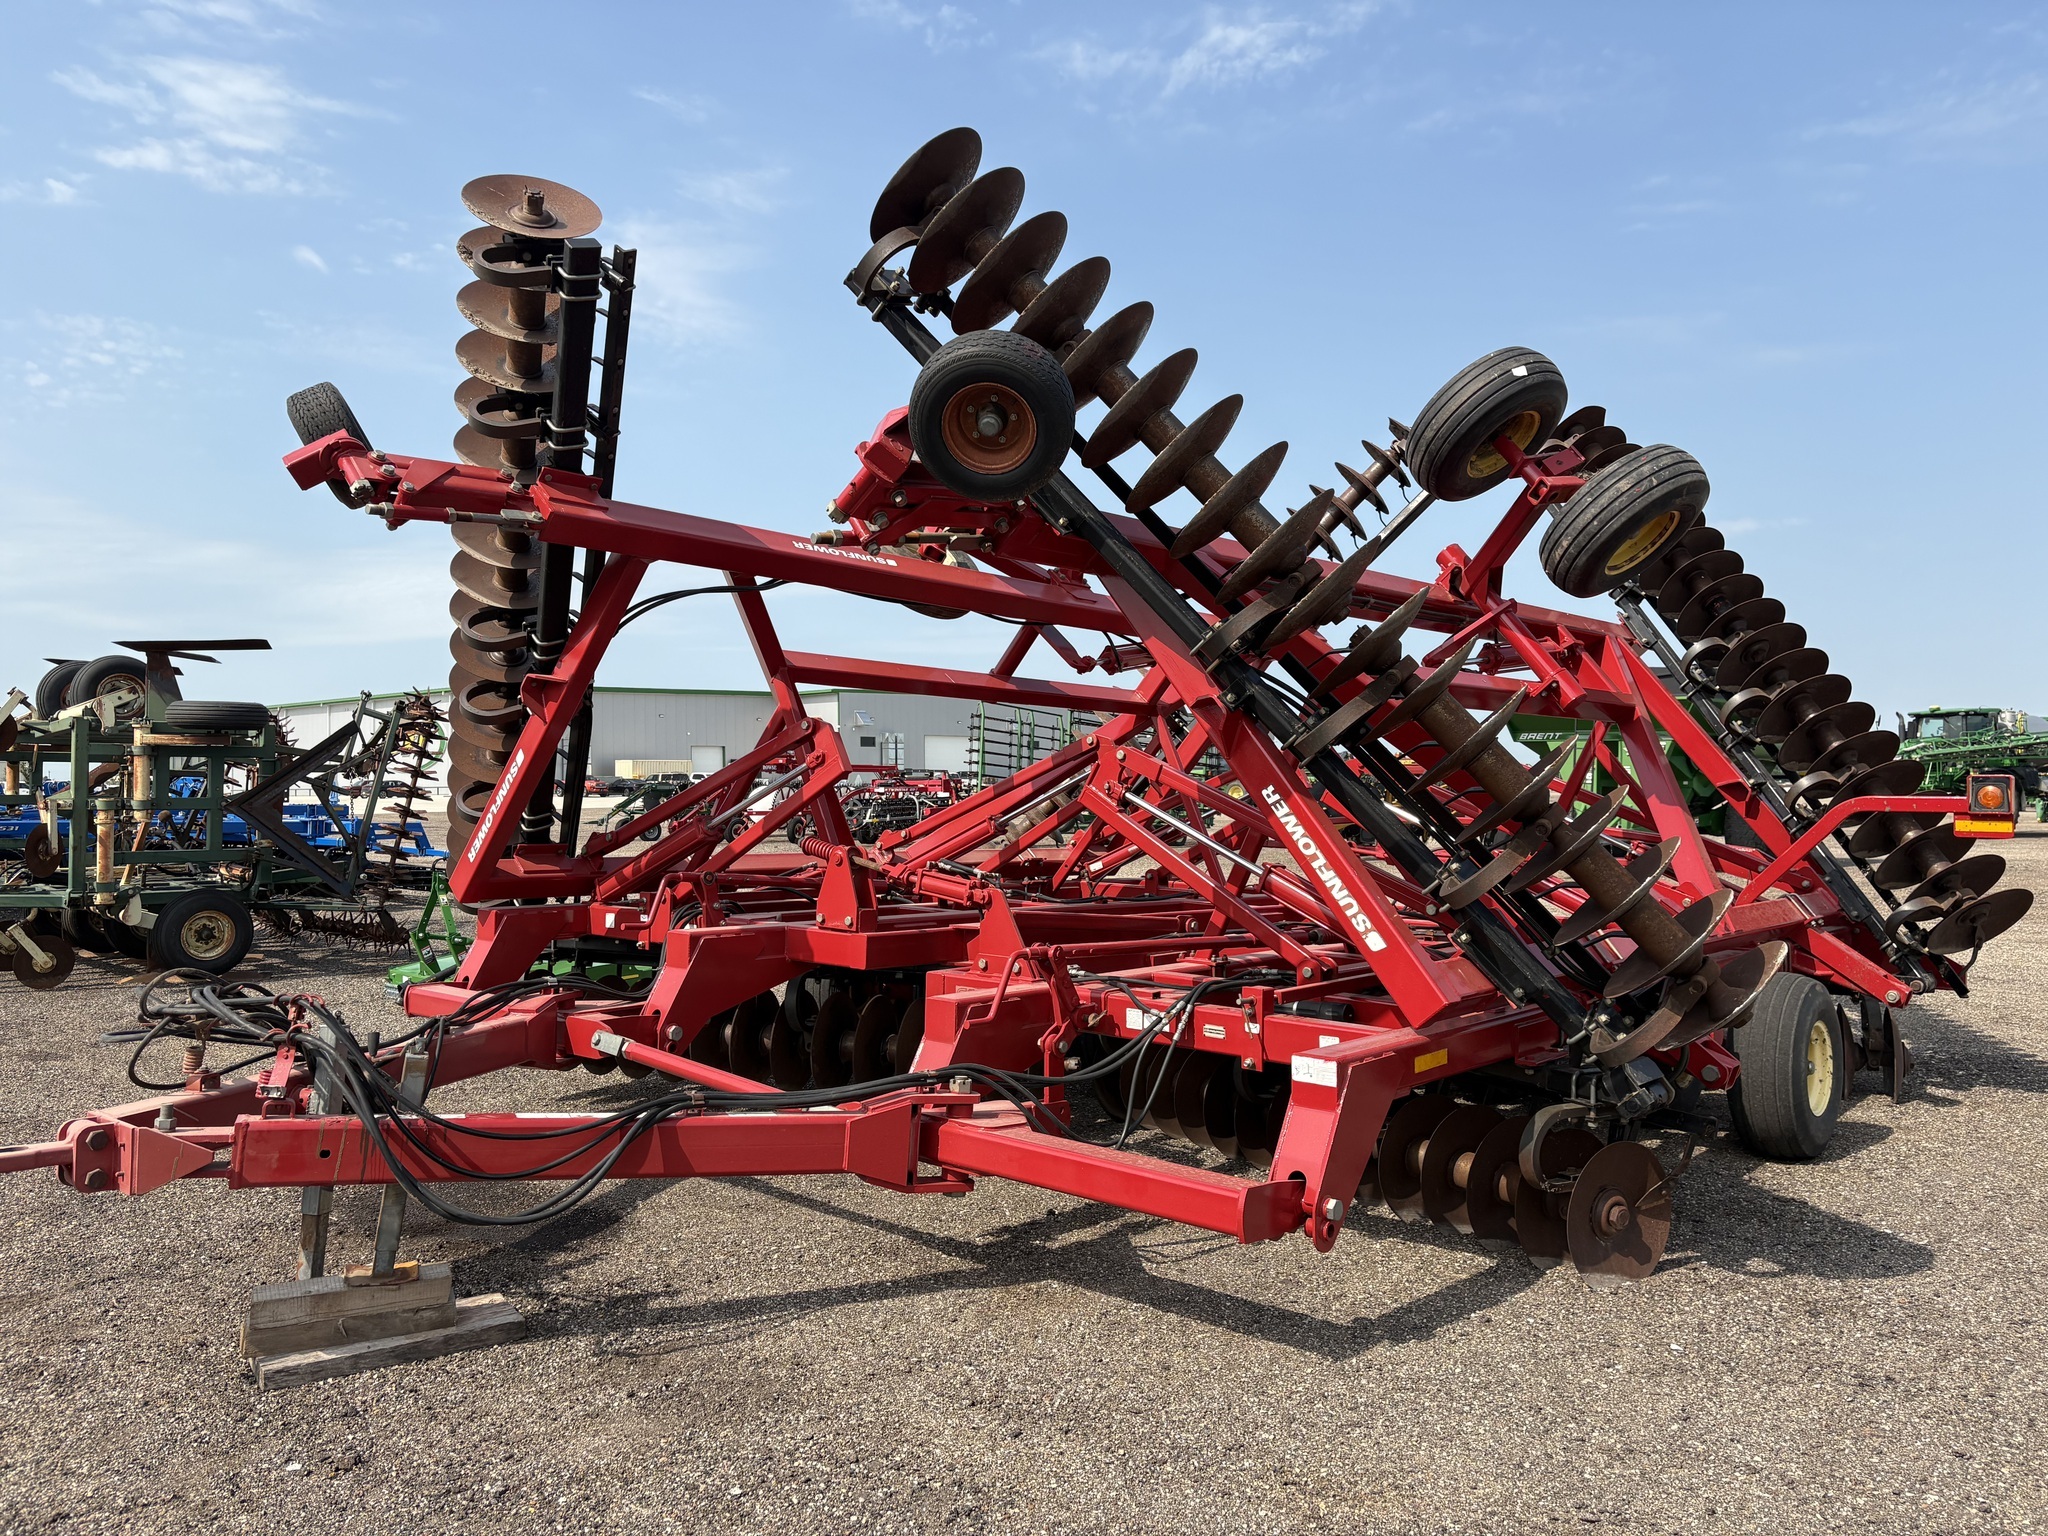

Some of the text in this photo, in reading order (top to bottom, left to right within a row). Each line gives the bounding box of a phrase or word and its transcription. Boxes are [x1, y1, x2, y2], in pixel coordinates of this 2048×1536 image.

[792, 541, 887, 565] SUNFLOWER
[1519, 732, 1563, 740] BRENT
[467, 761, 519, 863] SUNFLOWER
[1261, 784, 1372, 933] SUNFLOWER
